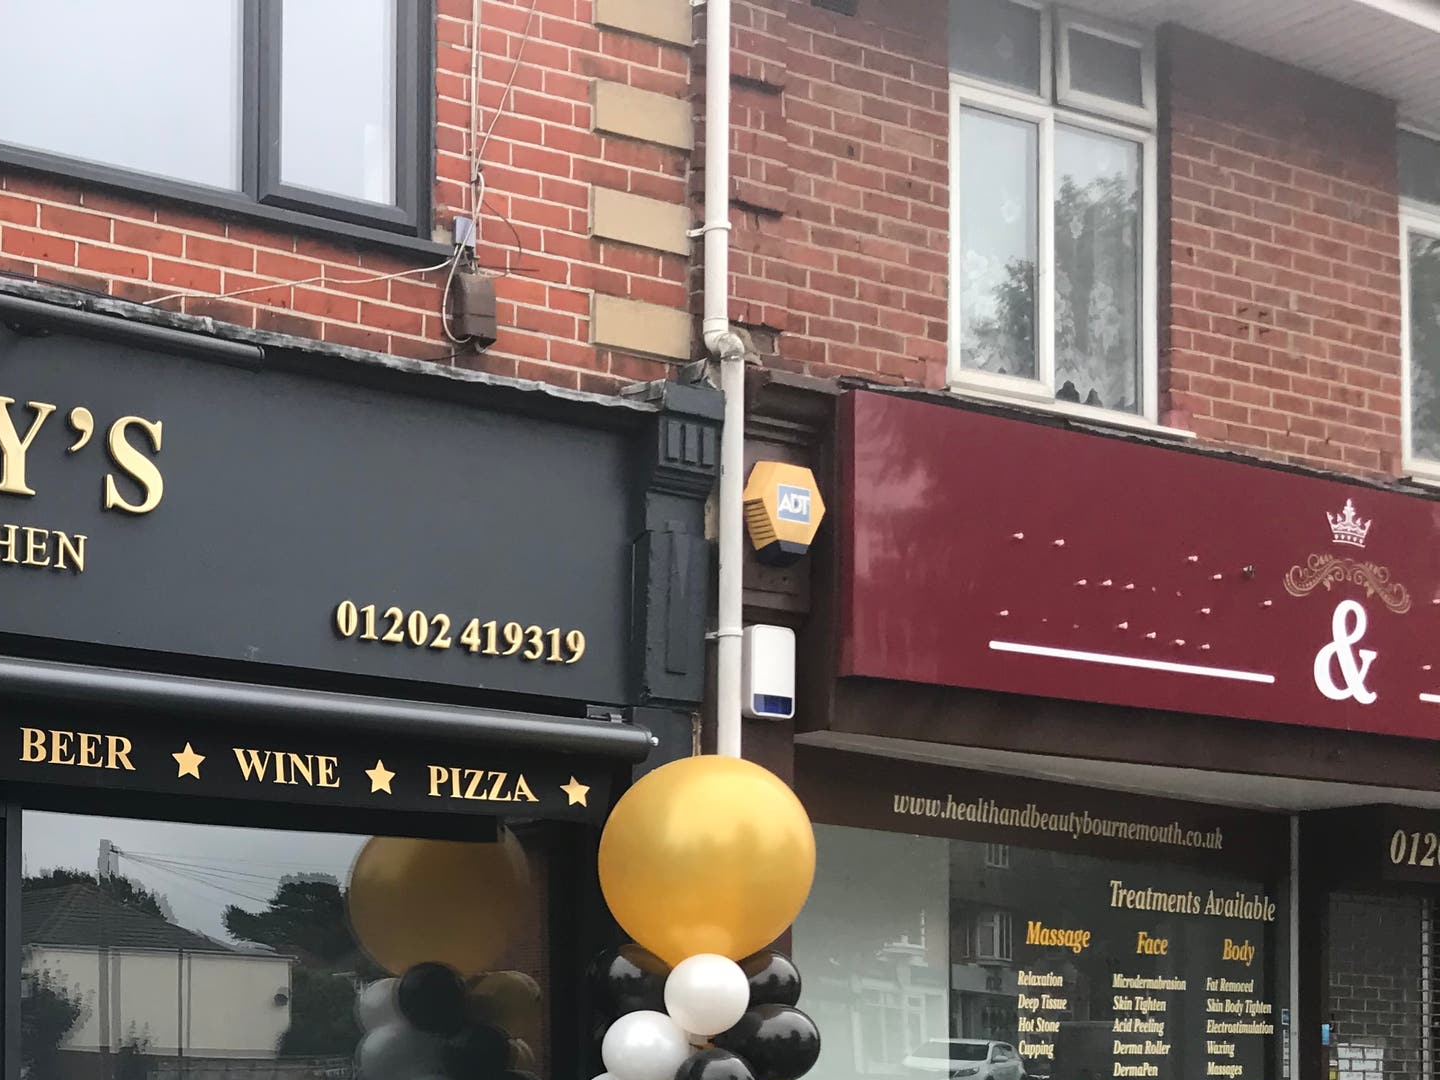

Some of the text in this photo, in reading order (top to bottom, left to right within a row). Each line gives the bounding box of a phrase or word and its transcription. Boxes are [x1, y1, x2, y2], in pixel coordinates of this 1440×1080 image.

[778, 491, 811, 516] ADT
[336, 600, 586, 664] 01202 419319
[1313, 599, 1378, 704] &
[19, 727, 136, 771] BEER
[233, 748, 340, 789] WINE
[427, 765, 539, 803] PIZZA
[893, 794, 1223, 850] www.healthandbeautybournemouth.co.uk
[1390, 829, 1440, 867] 012
[1110, 879, 1276, 921] Treatments Available
[1026, 921, 1091, 953] Massage
[1136, 931, 1169, 955] Face
[1222, 938, 1255, 966] Body
[1018, 971, 1063, 987] Relaxation
[1112, 974, 1187, 991] Microdermabrasion
[1206, 978, 1218, 992] Fat
[1018, 994, 1067, 1012] Deep Tissue
[1113, 996, 1166, 1014] Skin Tighten
[1206, 999, 1272, 1016] Skin Body Tighten
[1018, 1017, 1060, 1033] Hot Stone
[1112, 1019, 1165, 1036] Acid Peeling
[1206, 1020, 1274, 1035] Electrostimulation
[1018, 1041, 1054, 1059] Cupping
[1113, 1040, 1171, 1055] Derma Roller
[1206, 1041, 1235, 1058] Waxing
[1113, 1062, 1158, 1077] DermaPen
[1207, 1062, 1243, 1078] Massages
